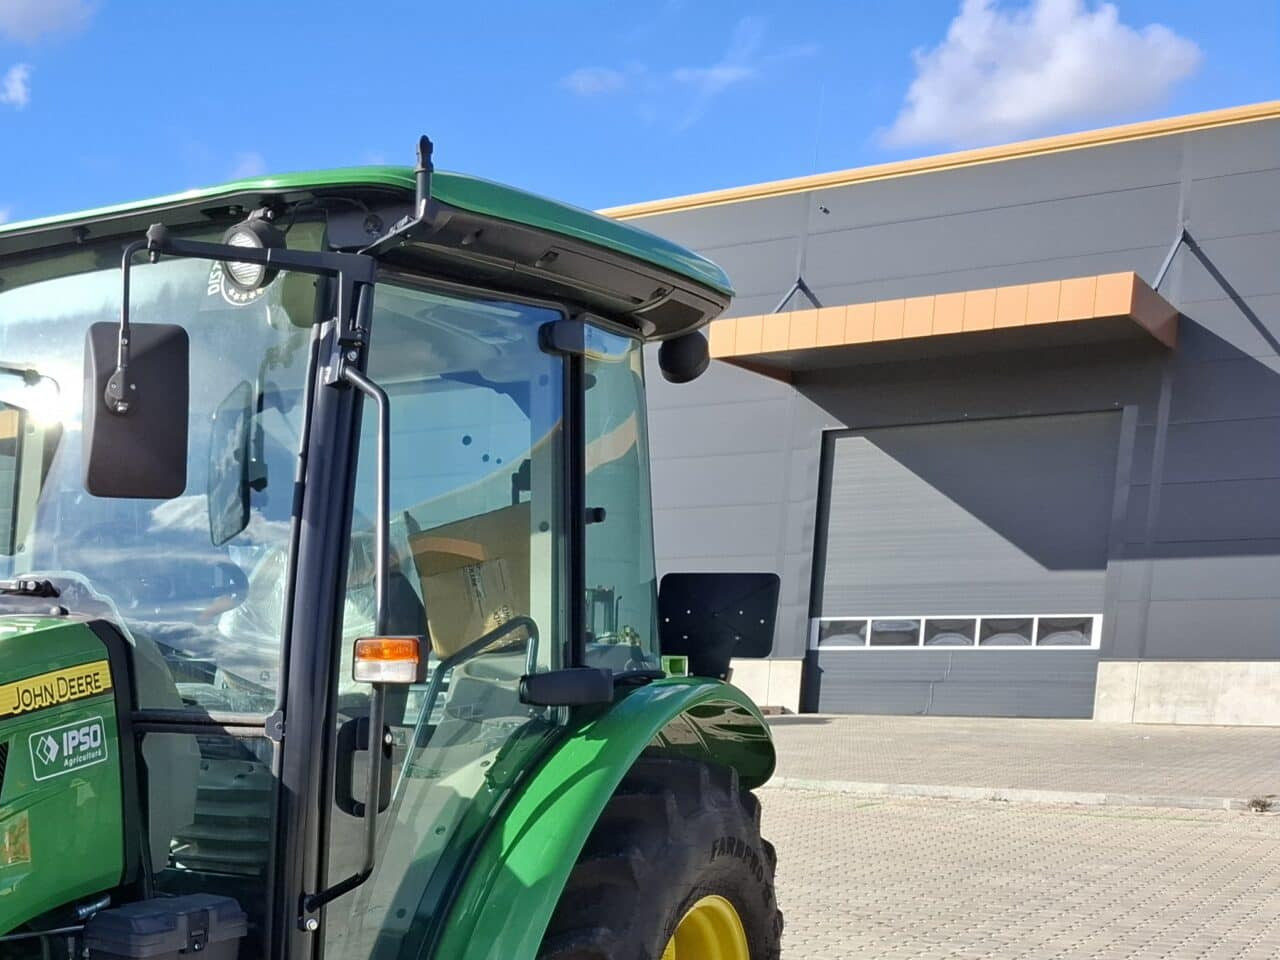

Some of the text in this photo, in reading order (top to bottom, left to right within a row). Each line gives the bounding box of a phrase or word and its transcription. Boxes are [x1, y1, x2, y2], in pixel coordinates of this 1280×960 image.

[13, 672, 102, 711] JOHN DEERE
[62, 723, 101, 757] IPSO
